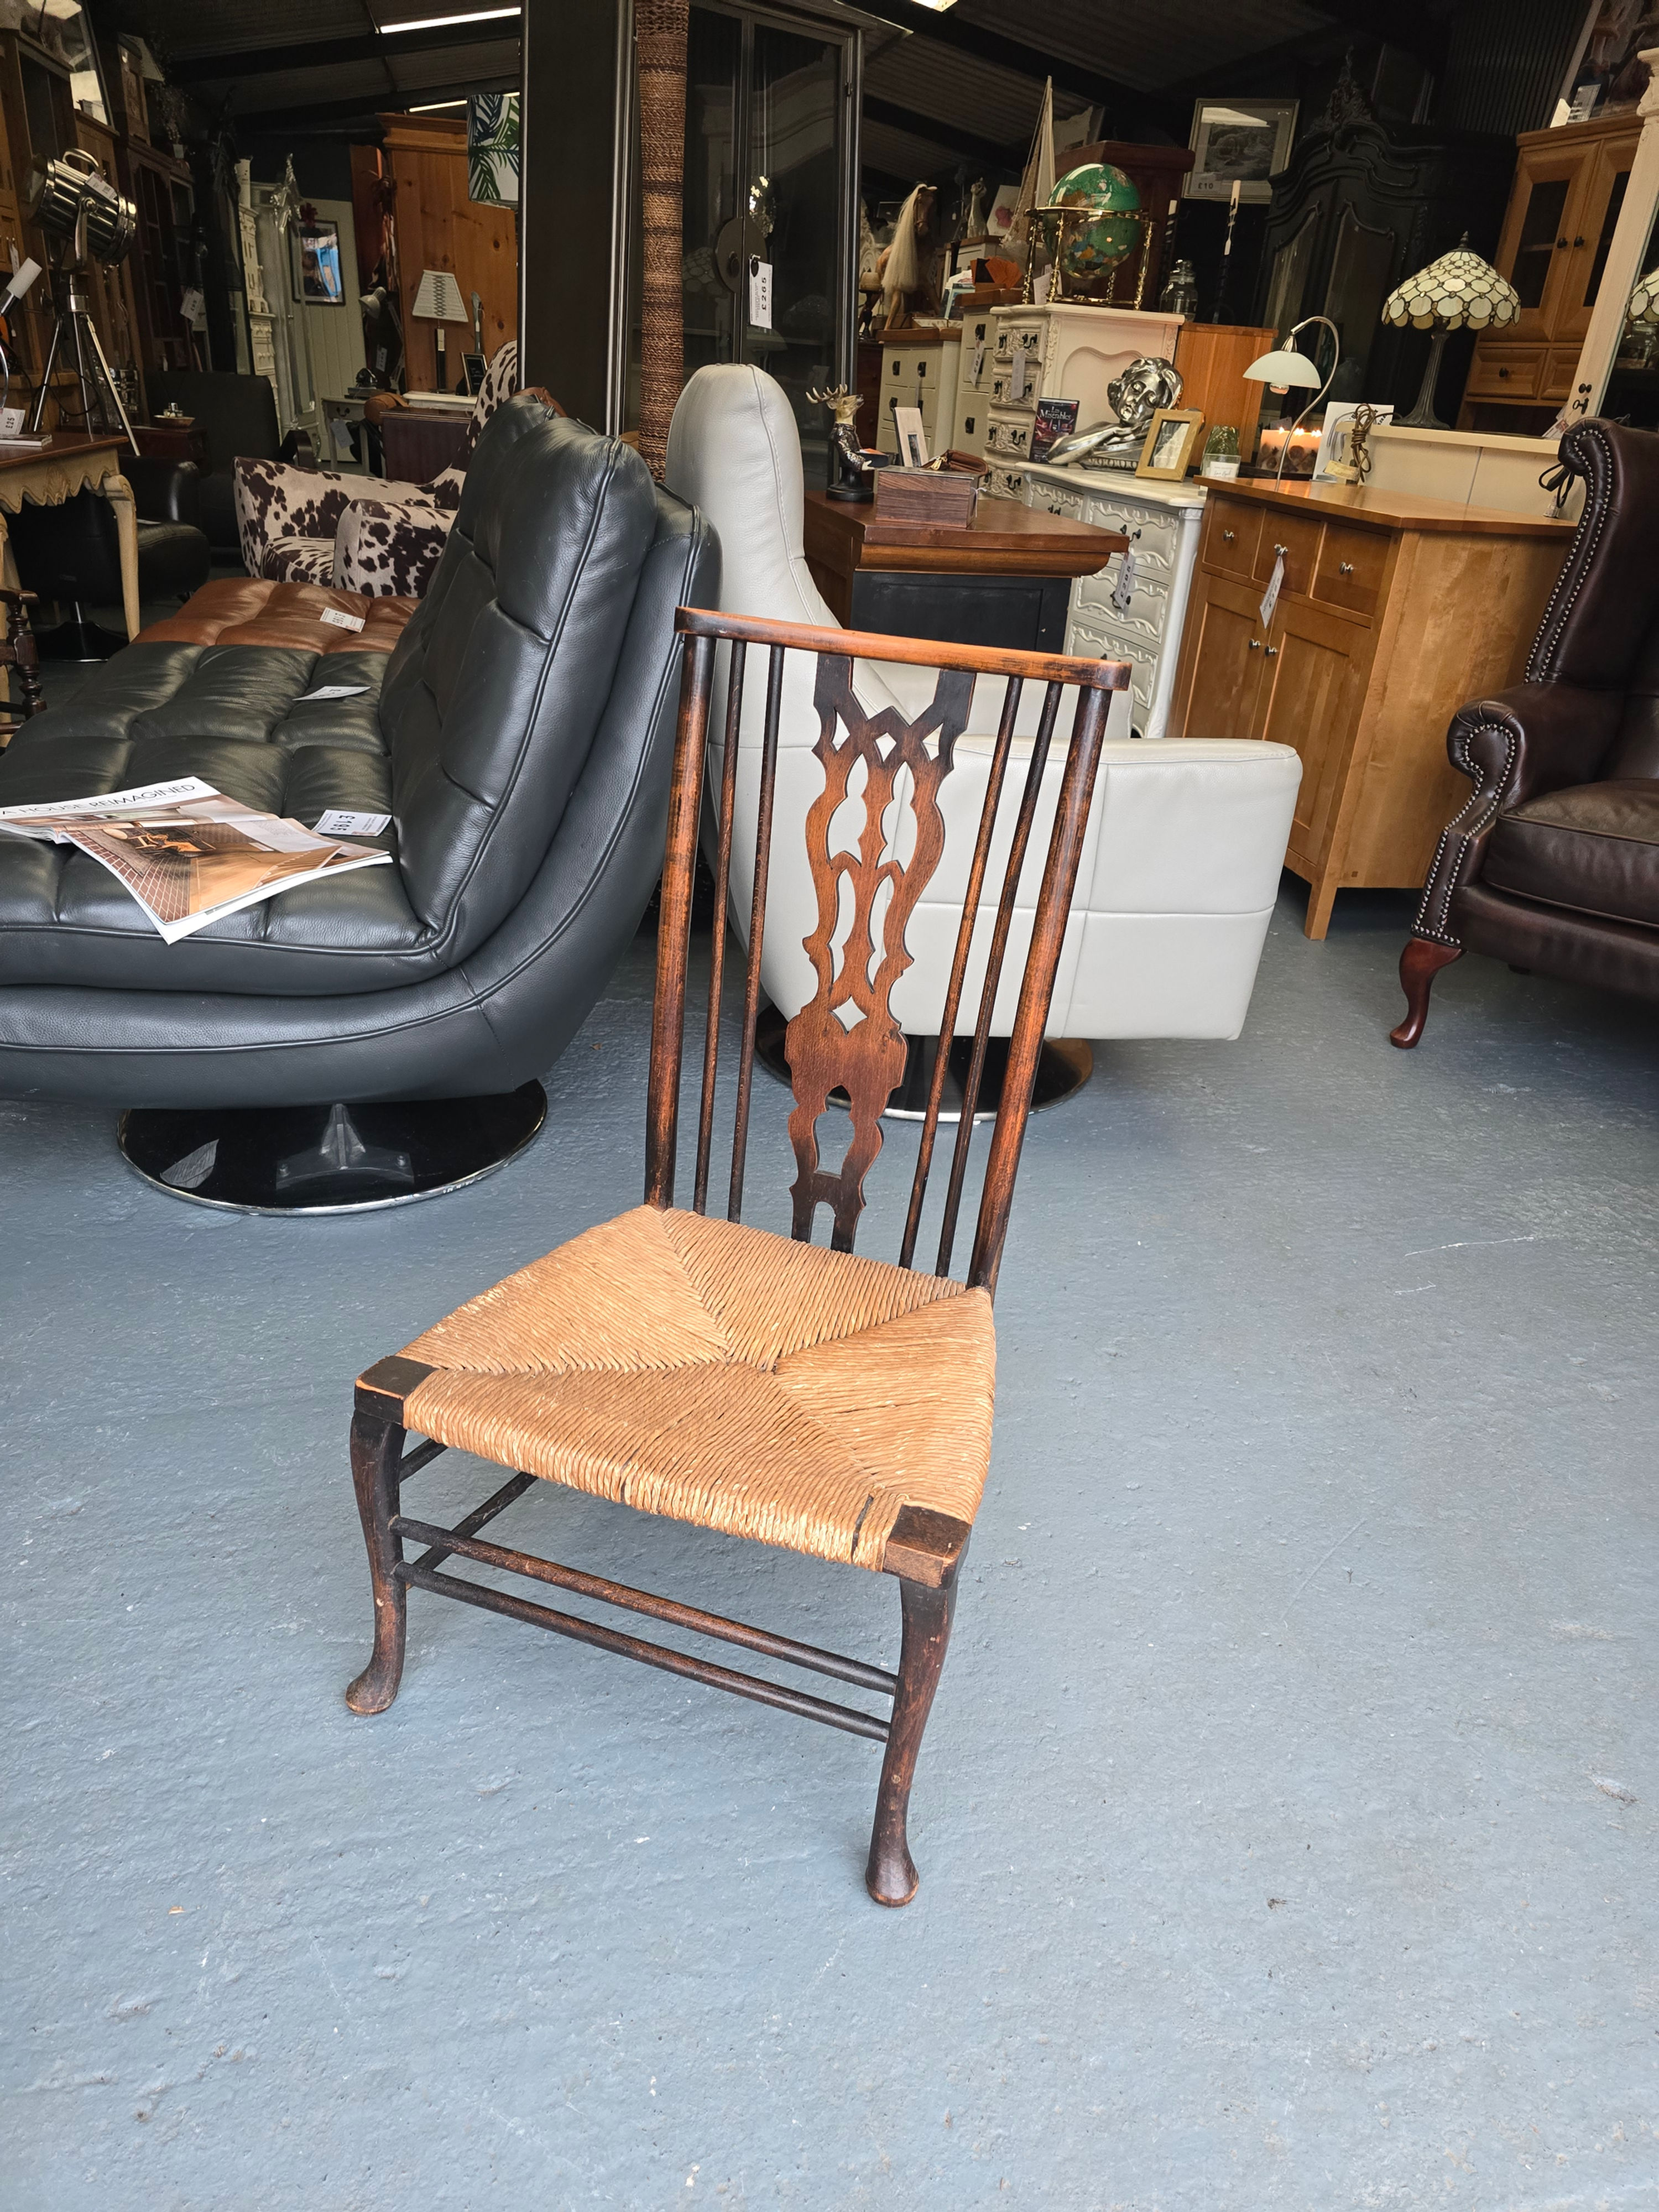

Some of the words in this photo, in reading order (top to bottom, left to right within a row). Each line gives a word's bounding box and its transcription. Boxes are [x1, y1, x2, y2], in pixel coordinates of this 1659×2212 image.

[5, 417, 15, 429] £25
[19, 803, 86, 814] HOUSE
[89, 784, 195, 808] REIMAGINED
[330, 815, 356, 831] £195
